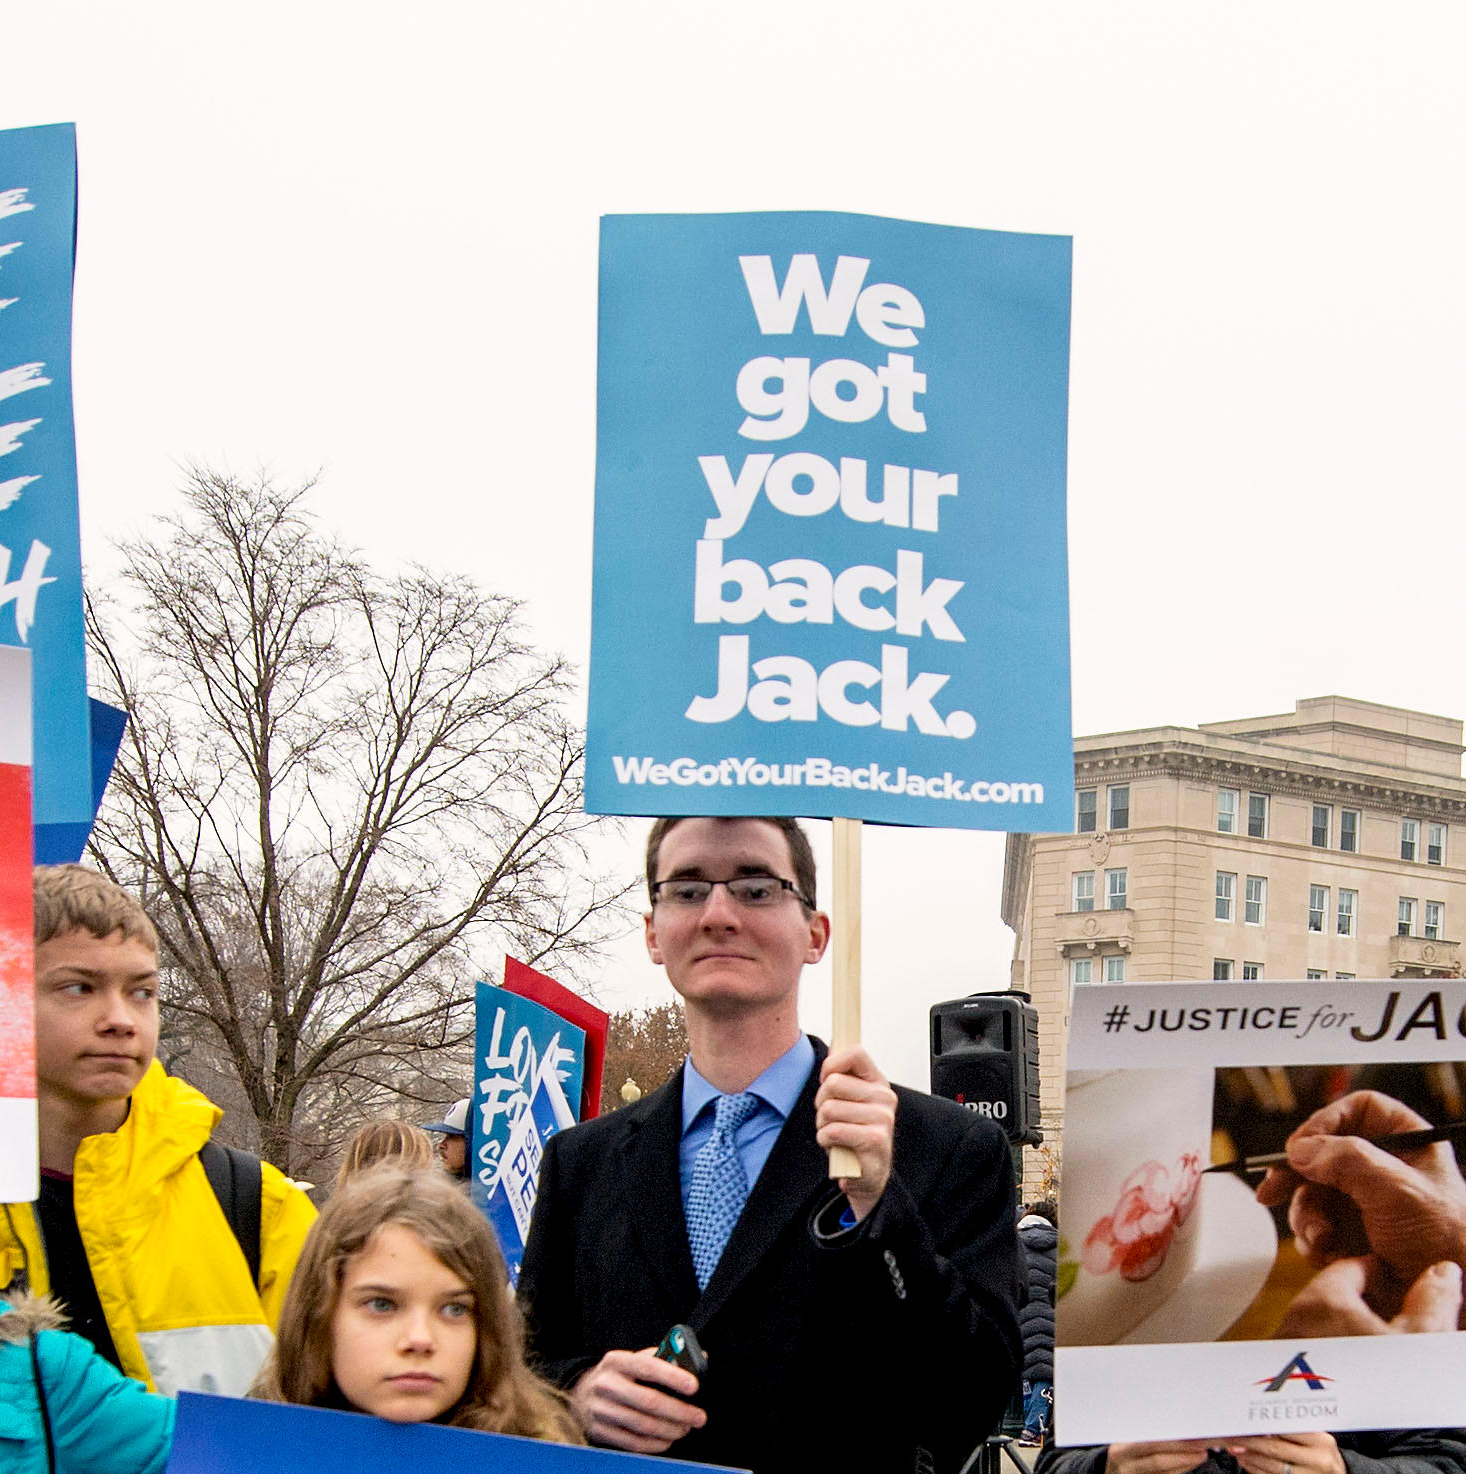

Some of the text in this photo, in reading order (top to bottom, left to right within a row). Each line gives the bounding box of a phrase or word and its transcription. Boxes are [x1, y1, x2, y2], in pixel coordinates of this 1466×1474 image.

[738, 253, 927, 348] We
[736, 352, 927, 441] got
[697, 452, 958, 541] your
[694, 539, 966, 643] back
[685, 635, 977, 739] Jack.
[612, 755, 1045, 805] WeGotYourBackJack.com
[484, 1006, 576, 1104] LOVE
[1103, 1004, 1302, 1034] #JUSTICE
[1296, 1003, 1356, 1039] for
[479, 1073, 530, 1136] FR
[1246, 1404, 1340, 1422] FREEDOM
